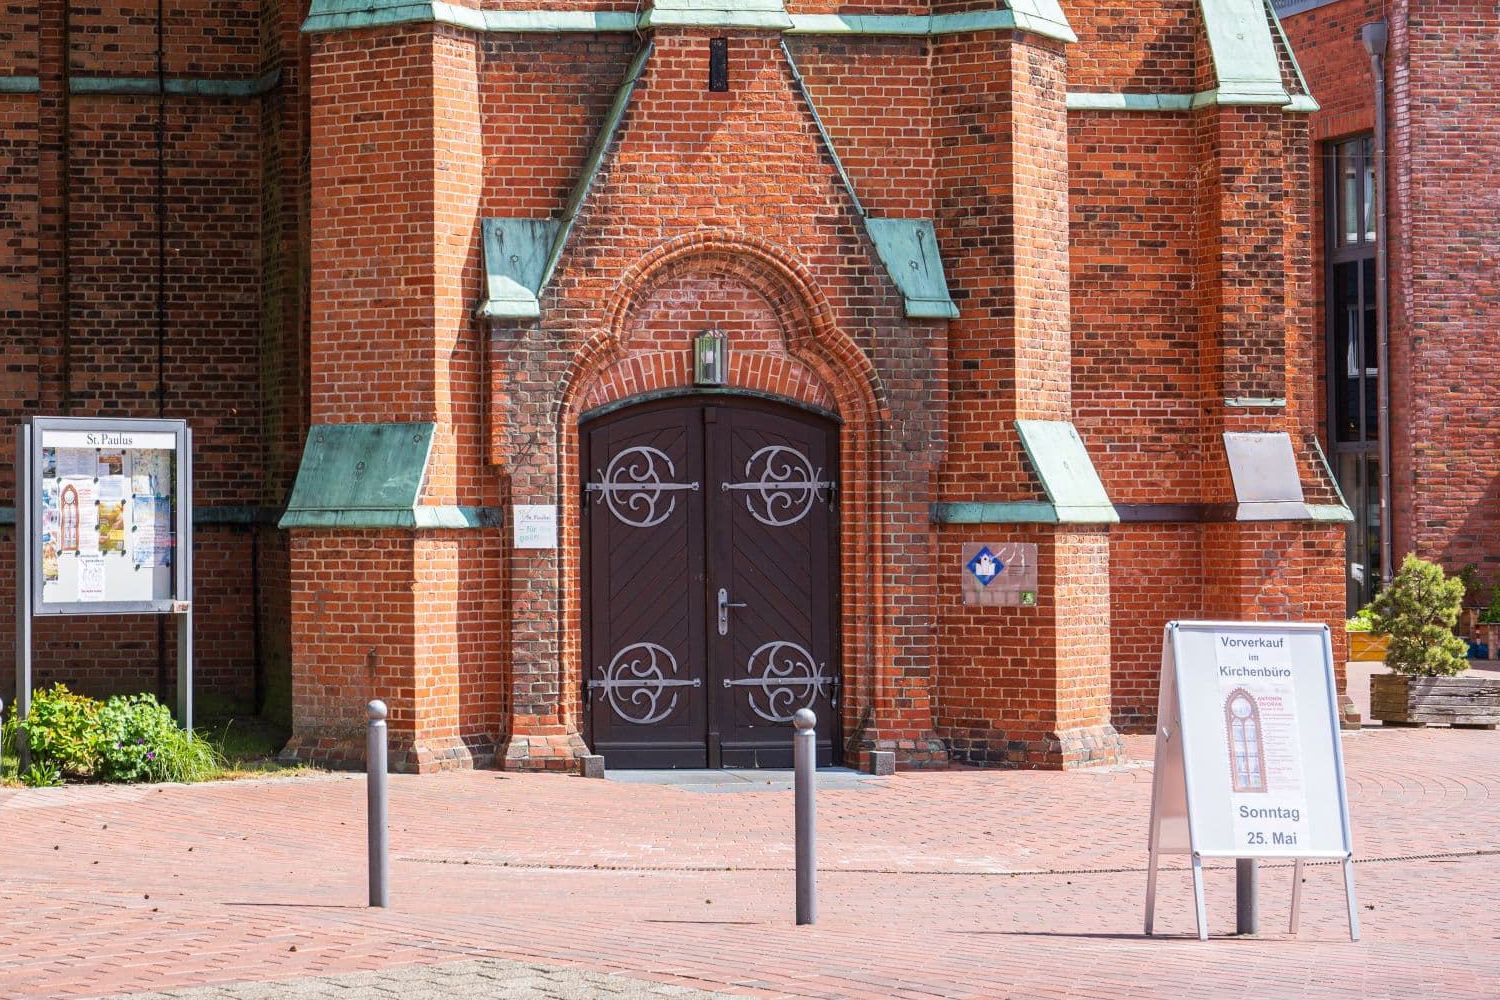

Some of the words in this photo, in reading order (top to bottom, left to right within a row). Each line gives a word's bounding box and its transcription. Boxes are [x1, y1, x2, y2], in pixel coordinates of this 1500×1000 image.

[86, 433, 100, 445] St.
[101, 432, 133, 445] Paulus
[1220, 636, 1284, 648] Vorverkauf
[1248, 653, 1259, 661] im
[1219, 666, 1291, 677] Kirchenbüro
[1239, 805, 1300, 821] Sonntag
[1247, 831, 1268, 844] 25.
[1272, 831, 1297, 844] Mai
